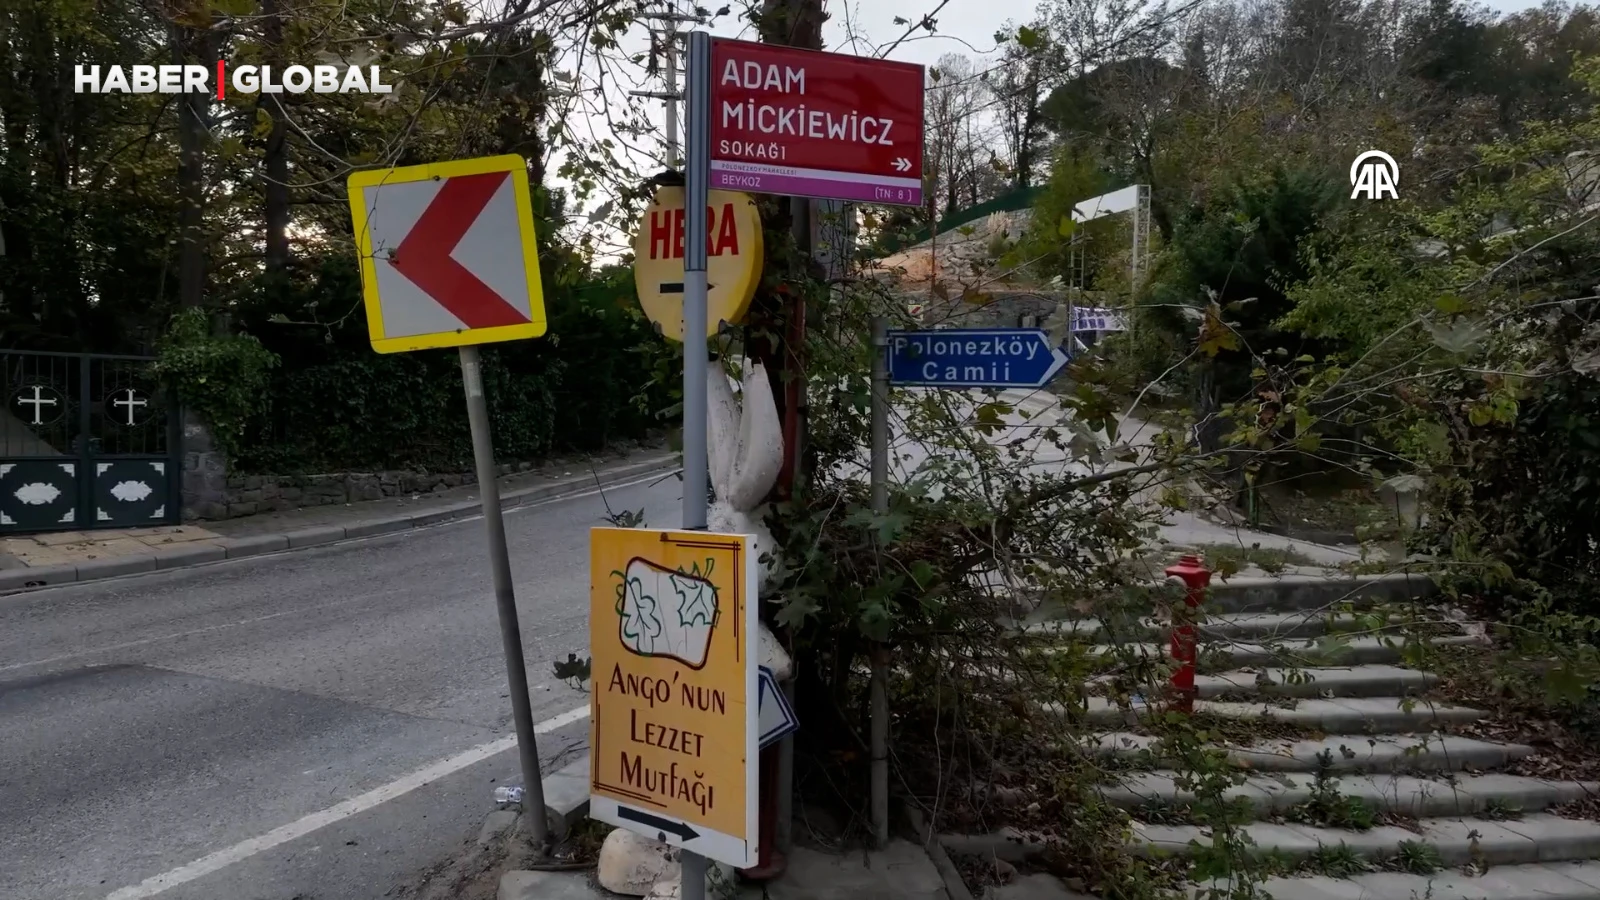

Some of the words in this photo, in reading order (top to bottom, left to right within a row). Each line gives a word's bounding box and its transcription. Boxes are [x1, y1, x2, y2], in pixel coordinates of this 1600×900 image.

[721, 59, 805, 95] ADAM
[722, 98, 894, 146] MİCKİEWİCZ
[719, 139, 786, 160] SOKAĞI
[721, 174, 761, 187] BEYKOZ
[894, 335, 1040, 360] Polonezköy
[922, 361, 1010, 382] Camii
